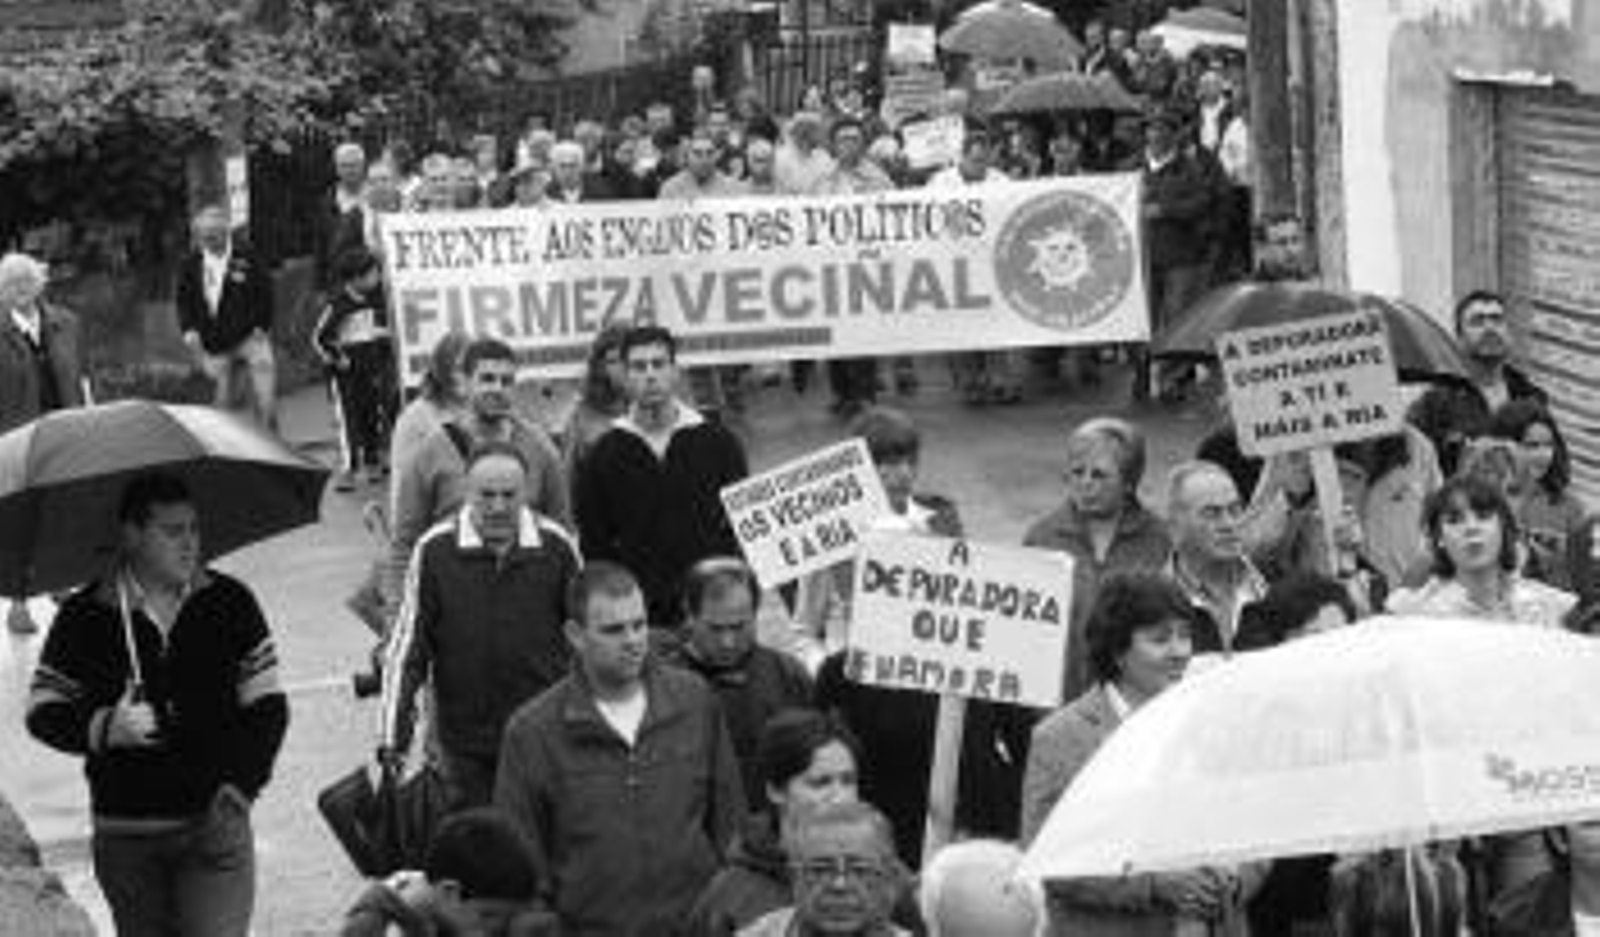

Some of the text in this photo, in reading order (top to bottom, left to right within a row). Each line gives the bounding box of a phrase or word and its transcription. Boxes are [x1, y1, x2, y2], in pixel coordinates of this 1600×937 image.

[390, 226, 529, 269] FRENTE
[542, 217, 594, 262] AOS
[401, 276, 656, 345] FIRMEZA
[671, 249, 991, 324] VECIÑAL
[948, 540, 969, 566] A
